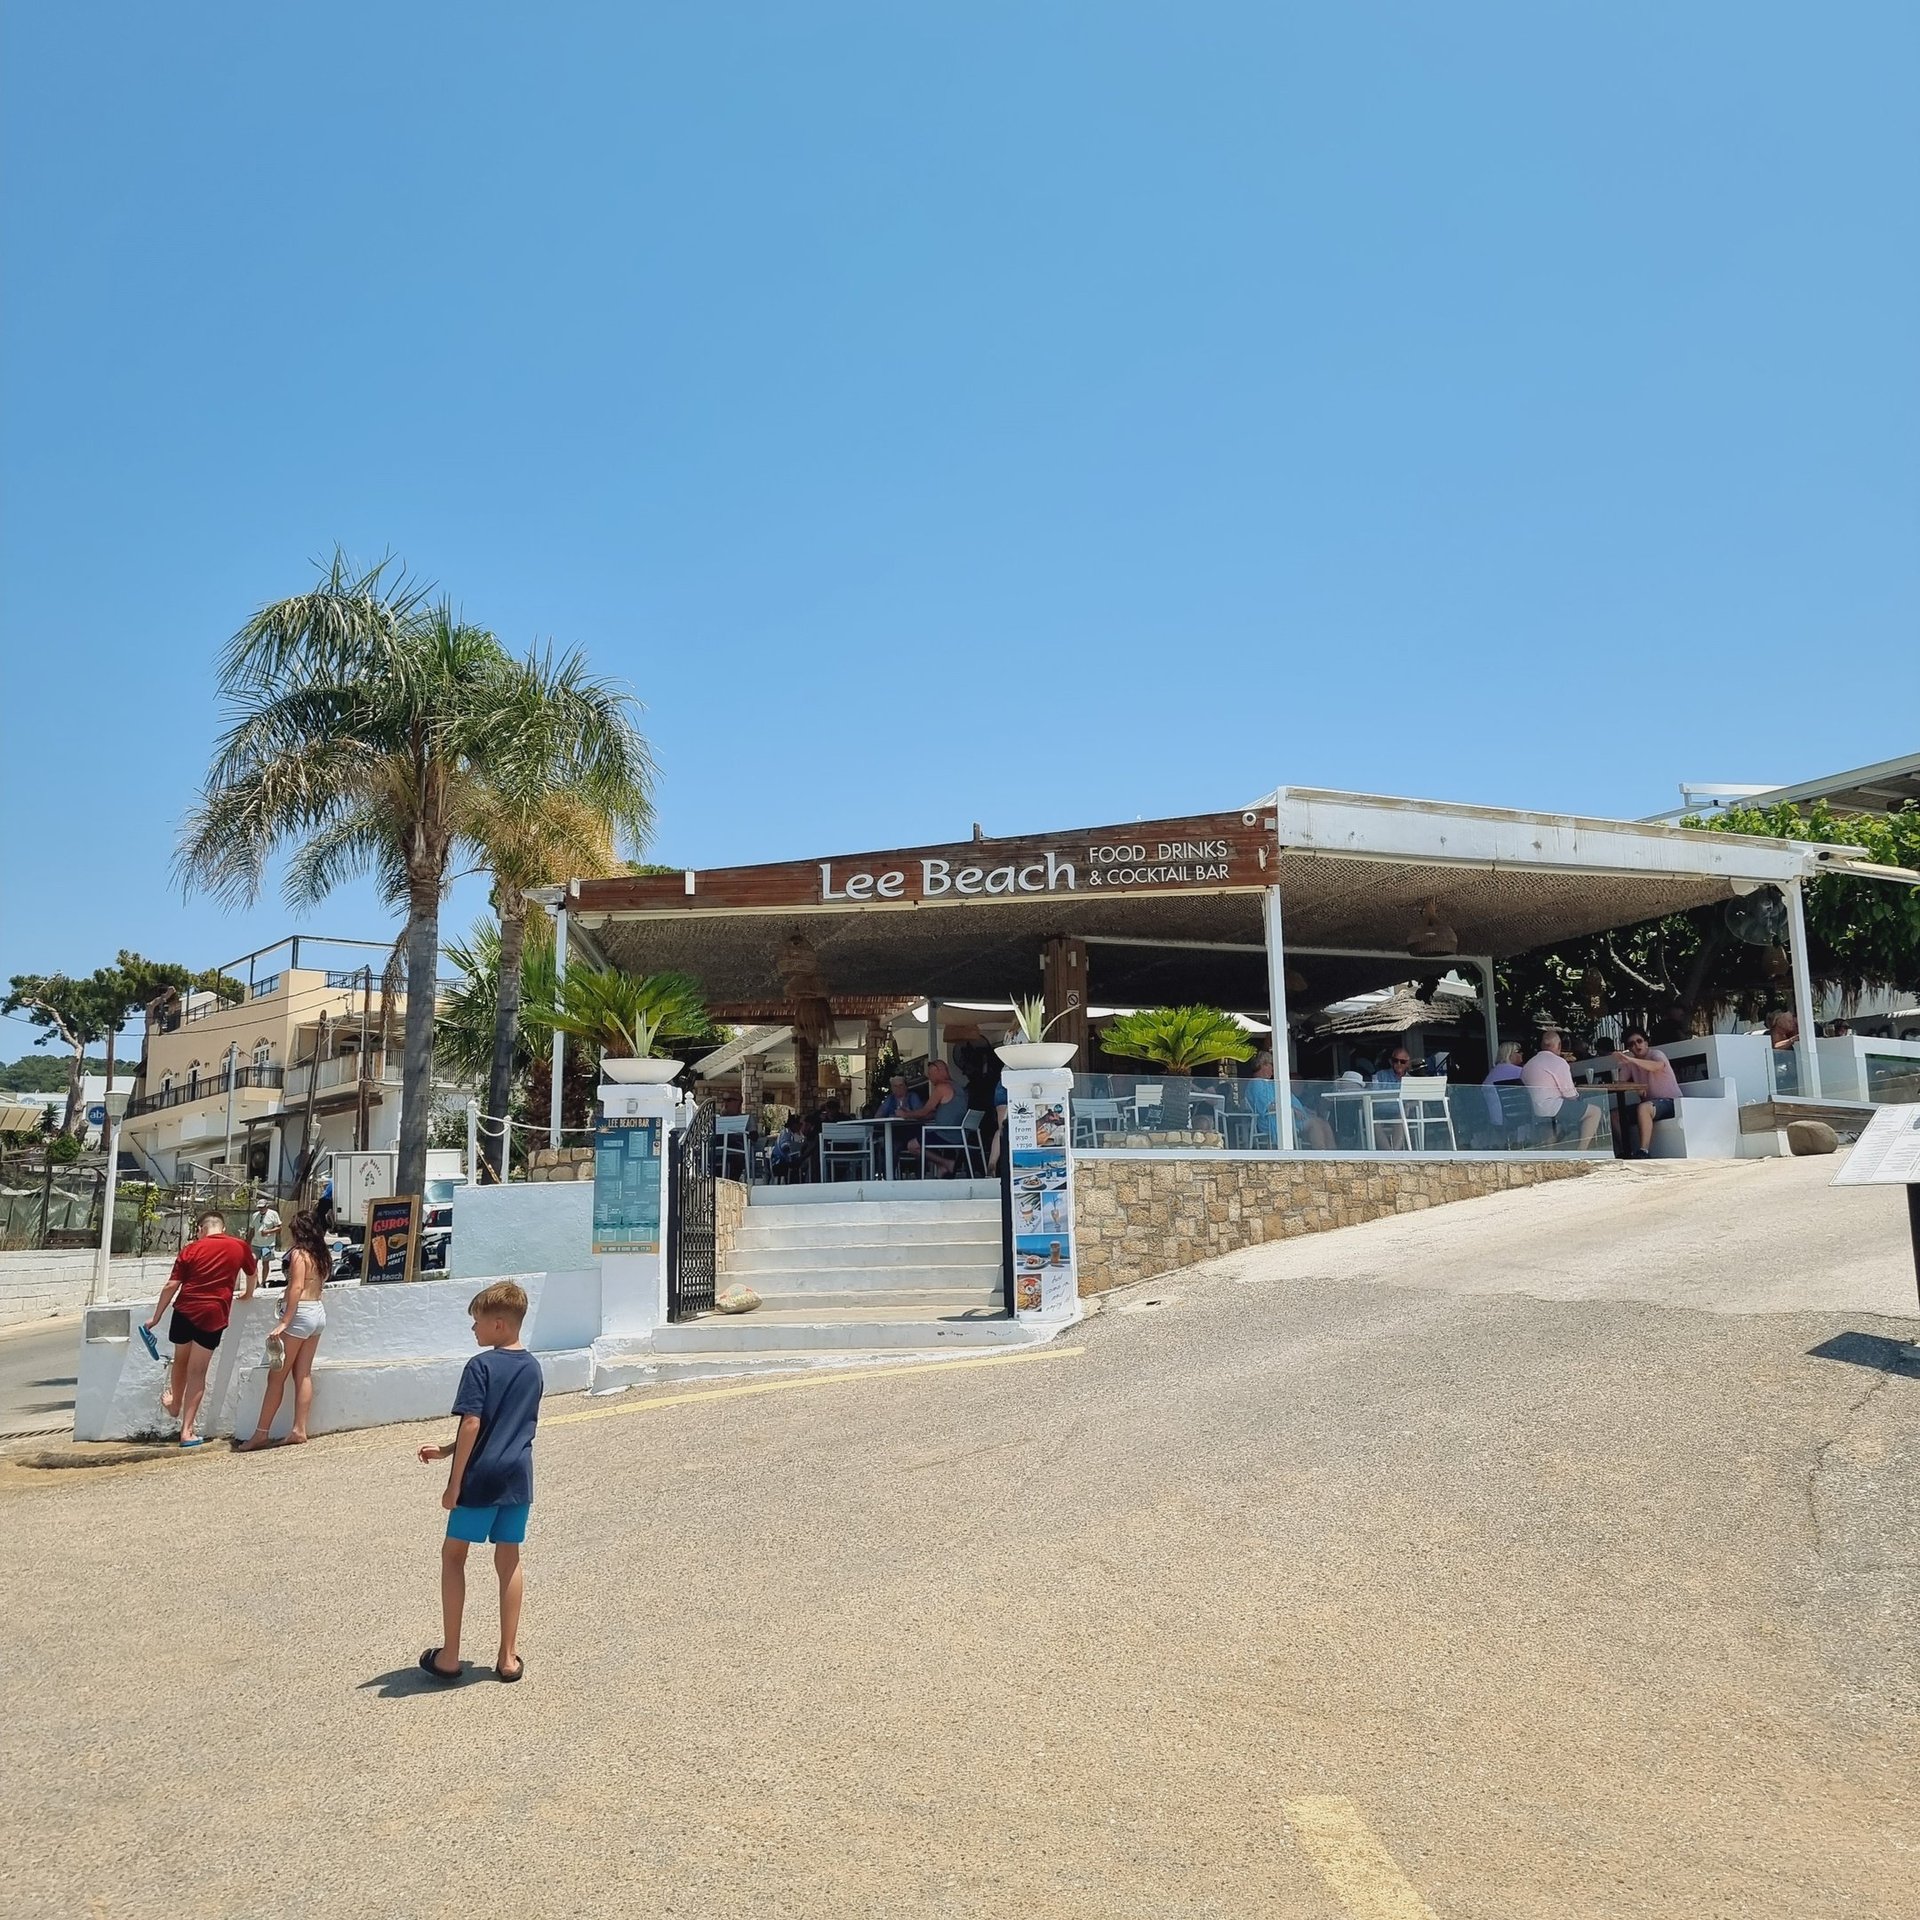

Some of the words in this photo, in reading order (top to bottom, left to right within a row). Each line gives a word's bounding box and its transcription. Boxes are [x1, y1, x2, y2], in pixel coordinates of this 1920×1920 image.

[1089, 845, 1146, 863] FOOD
[1158, 840, 1227, 860] DRINKS
[819, 863, 905, 899] Lee
[920, 852, 1075, 895] Beach
[1089, 870, 1102, 885] &
[1107, 866, 1191, 884] COCKTAIL
[1195, 864, 1230, 880] BAR
[608, 1119, 619, 1128] LEE
[620, 1118, 637, 1128] BEACH
[638, 1118, 650, 1128] BAR
[373, 1217, 409, 1232] GYROS
[387, 1250, 406, 1260] SERVED
[368, 1273, 381, 1281] Lee
[382, 1272, 403, 1281] Beach
